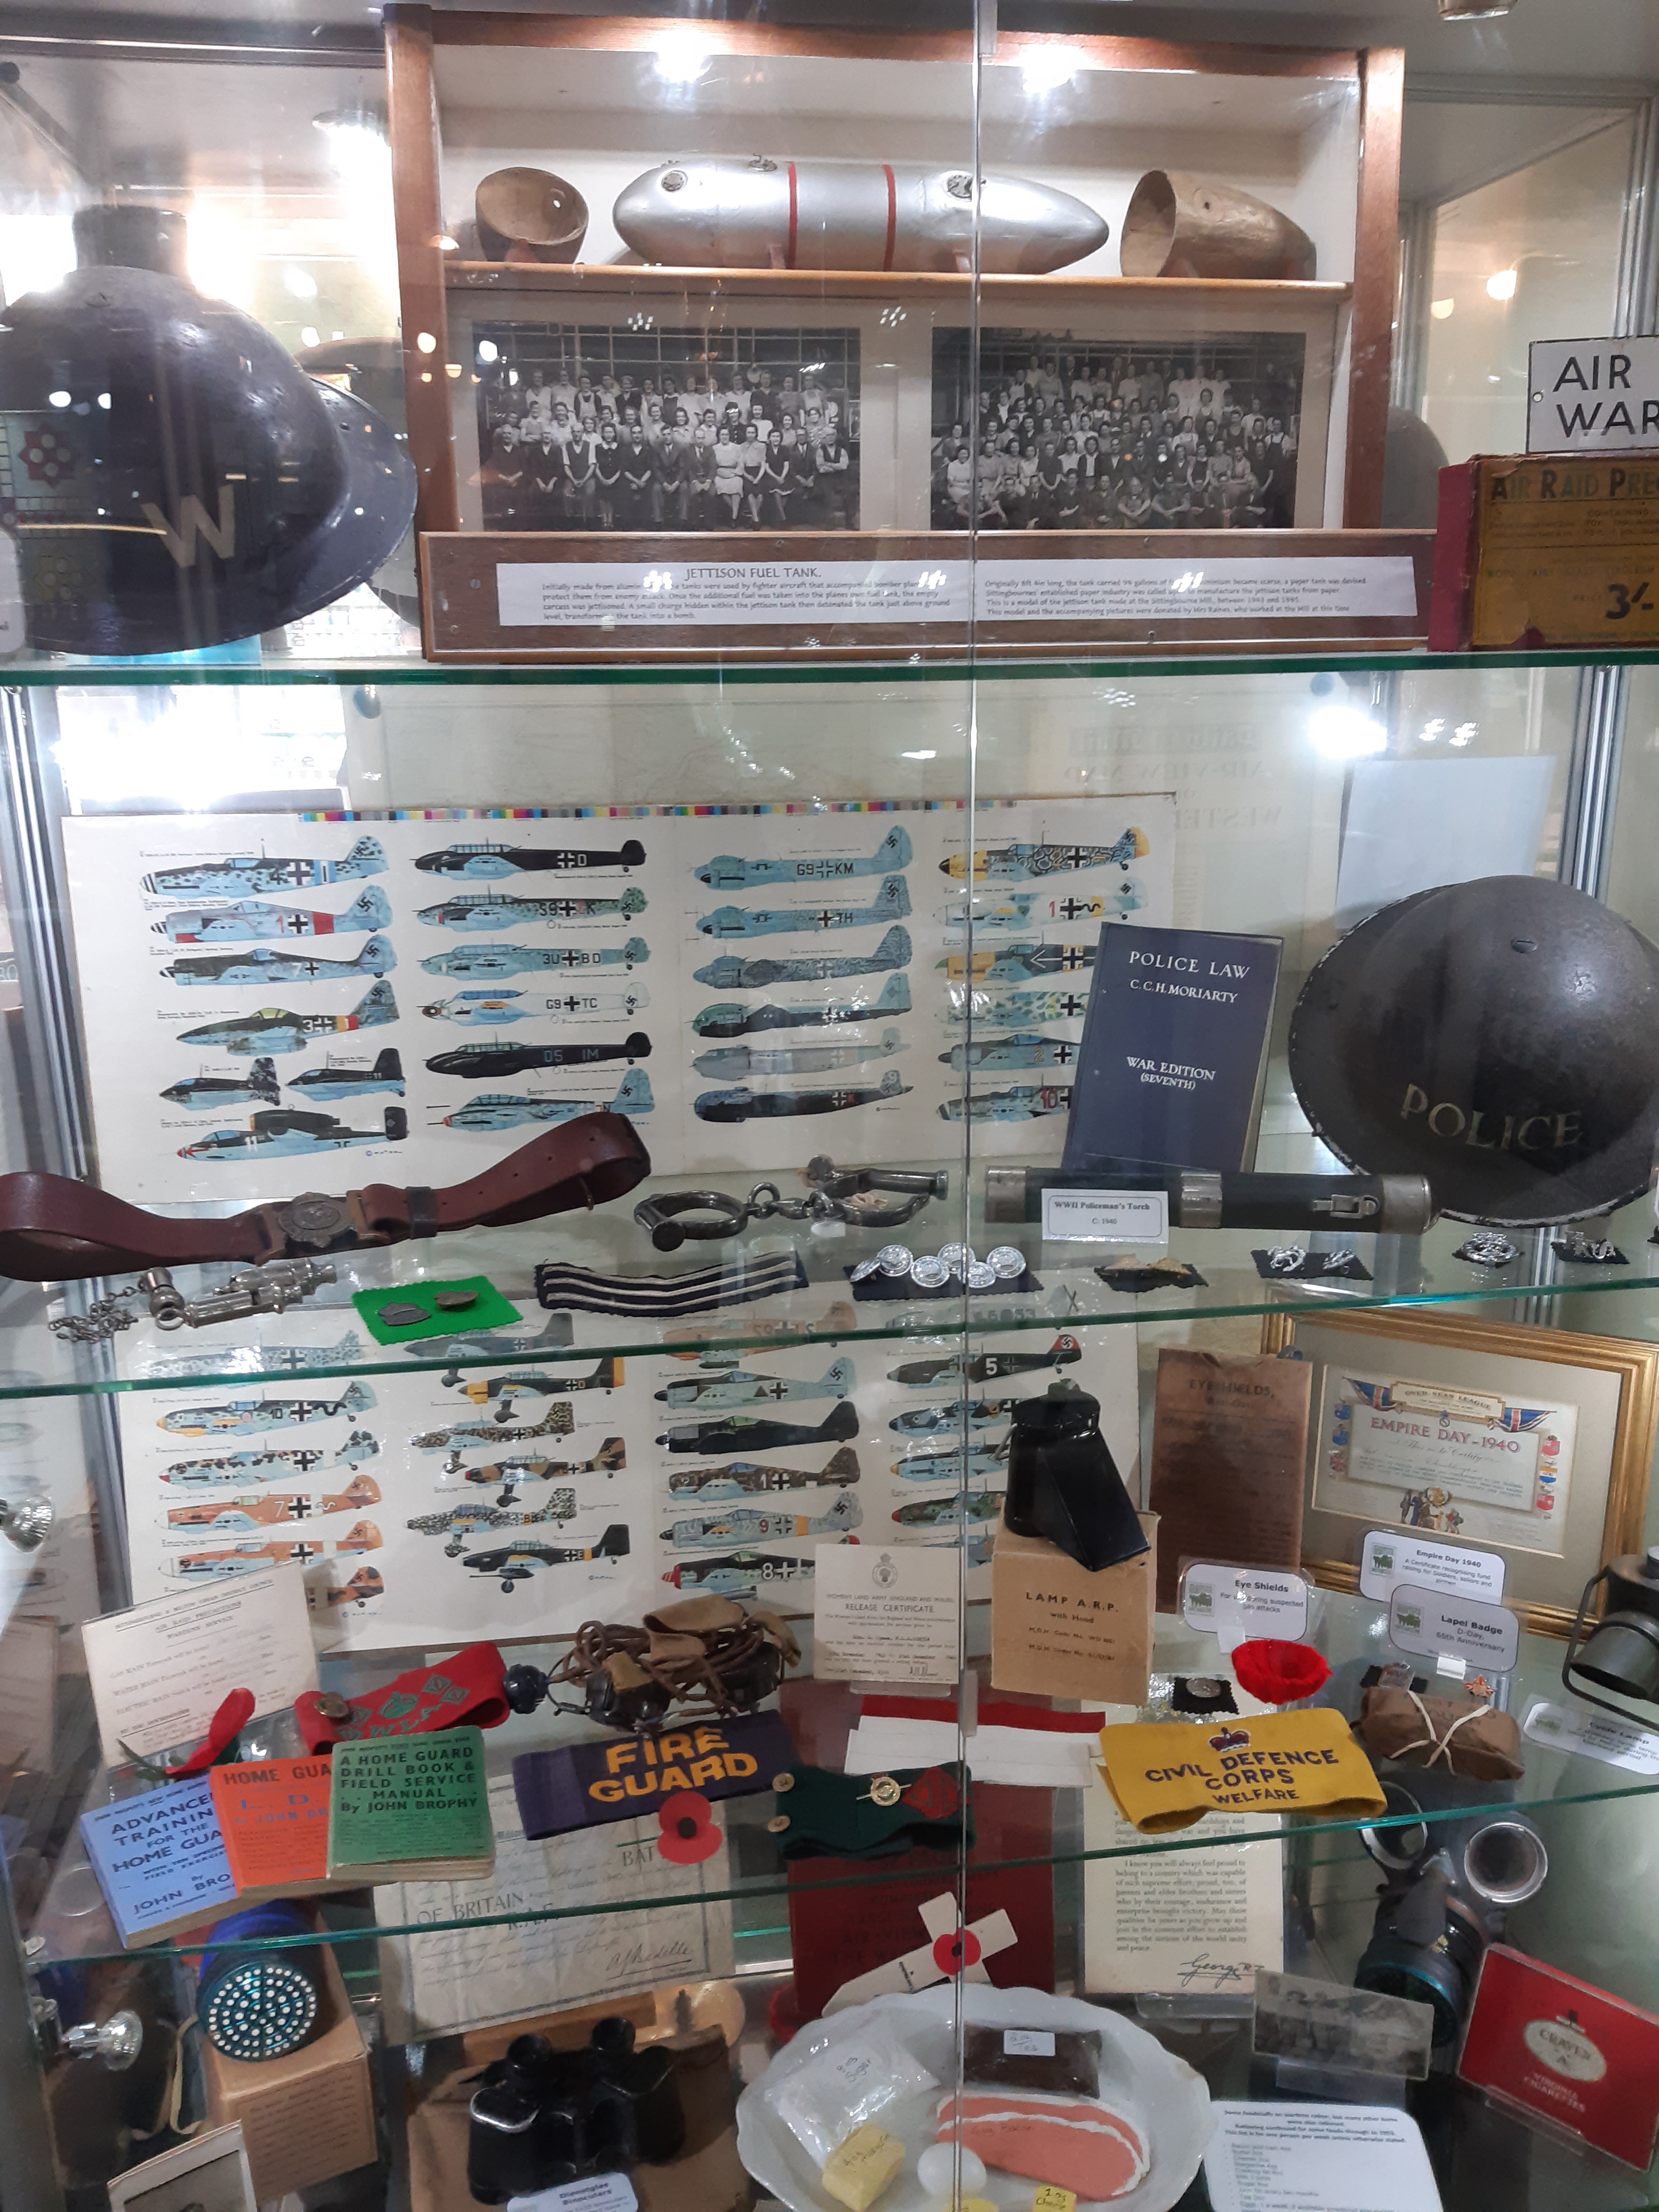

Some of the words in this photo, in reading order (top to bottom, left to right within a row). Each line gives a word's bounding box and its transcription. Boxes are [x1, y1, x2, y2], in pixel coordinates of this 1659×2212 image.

[1552, 354, 1632, 393] AIR
[1491, 474, 1532, 500] AIR
[1540, 469, 1599, 499] RAID
[141, 484, 235, 568] W
[685, 568, 745, 580] JETTISON
[750, 568, 780, 577] FUEL
[783, 567, 821, 577] TANK.
[1605, 582, 1654, 620] 3/-
[797, 864, 814, 876] G9
[835, 862, 854, 875] KM
[540, 902, 557, 916] S9
[543, 954, 559, 964] 3U
[1128, 950, 1199, 973] POLICE
[1208, 962, 1250, 979] LAW
[292, 962, 302, 977] 7
[546, 998, 561, 1010] G9
[582, 998, 598, 1009] TC
[302, 1020, 313, 1034] 3
[1126, 1056, 1156, 1071] WAR
[1160, 1062, 1216, 1081] EDITION
[1140, 1072, 1196, 1091] (SEVENTH)
[1040, 1091, 1058, 1109] 10
[1400, 1083, 1583, 1151] POLICE
[986, 1358, 998, 1375] 5
[1370, 1417, 1430, 1438] EMPIRE
[758, 1519, 769, 1534] 9
[1417, 1550, 1443, 1560] Empire
[1445, 1555, 1460, 1564] Day
[1462, 1559, 1481, 1567] 1940
[762, 1563, 774, 1580] 8
[1235, 1580, 1251, 1588] Eye
[1255, 1582, 1288, 1592] Shields
[883, 1604, 933, 1612] CERTIFICATE
[1026, 1592, 1067, 1604] LAMP
[1077, 1599, 1119, 1612] A.R.P.
[1442, 1615, 1467, 1626] Lapel
[1471, 1622, 1502, 1635] Badge
[1436, 1632, 1454, 1640] 65th
[1457, 1636, 1505, 1652] Anniversary
[340, 1756, 350, 1766] A
[359, 1753, 407, 1765] HOME
[415, 1747, 473, 1761] GUARD
[605, 1726, 730, 1774] FIRE
[340, 1767, 396, 1777] DRILL
[406, 1762, 455, 1775] BOOK
[1145, 1764, 1214, 1783] CIVIL
[1220, 1749, 1339, 1771] DEFENCE
[224, 1768, 280, 1785] HOME
[340, 1779, 391, 1789] FIELD
[404, 1773, 476, 1787] SERVICE
[589, 1752, 758, 1803] GUARD
[1205, 1768, 1295, 1791] CORPS
[373, 1788, 446, 1800] MANUAL
[1212, 1789, 1299, 1805] WELFARE
[111, 1793, 214, 1835] ADVANCE
[340, 1803, 361, 1814] By
[368, 1800, 408, 1814] JOHN
[113, 1808, 214, 1847] TRAININ
[146, 1834, 175, 1848] FOR
[180, 1822, 209, 1837] THE
[111, 1846, 173, 1873] HOME
[133, 1890, 183, 1914] JOHN
[194, 1873, 231, 1891] BRO
[452, 1890, 524, 1919] BRITAIN
